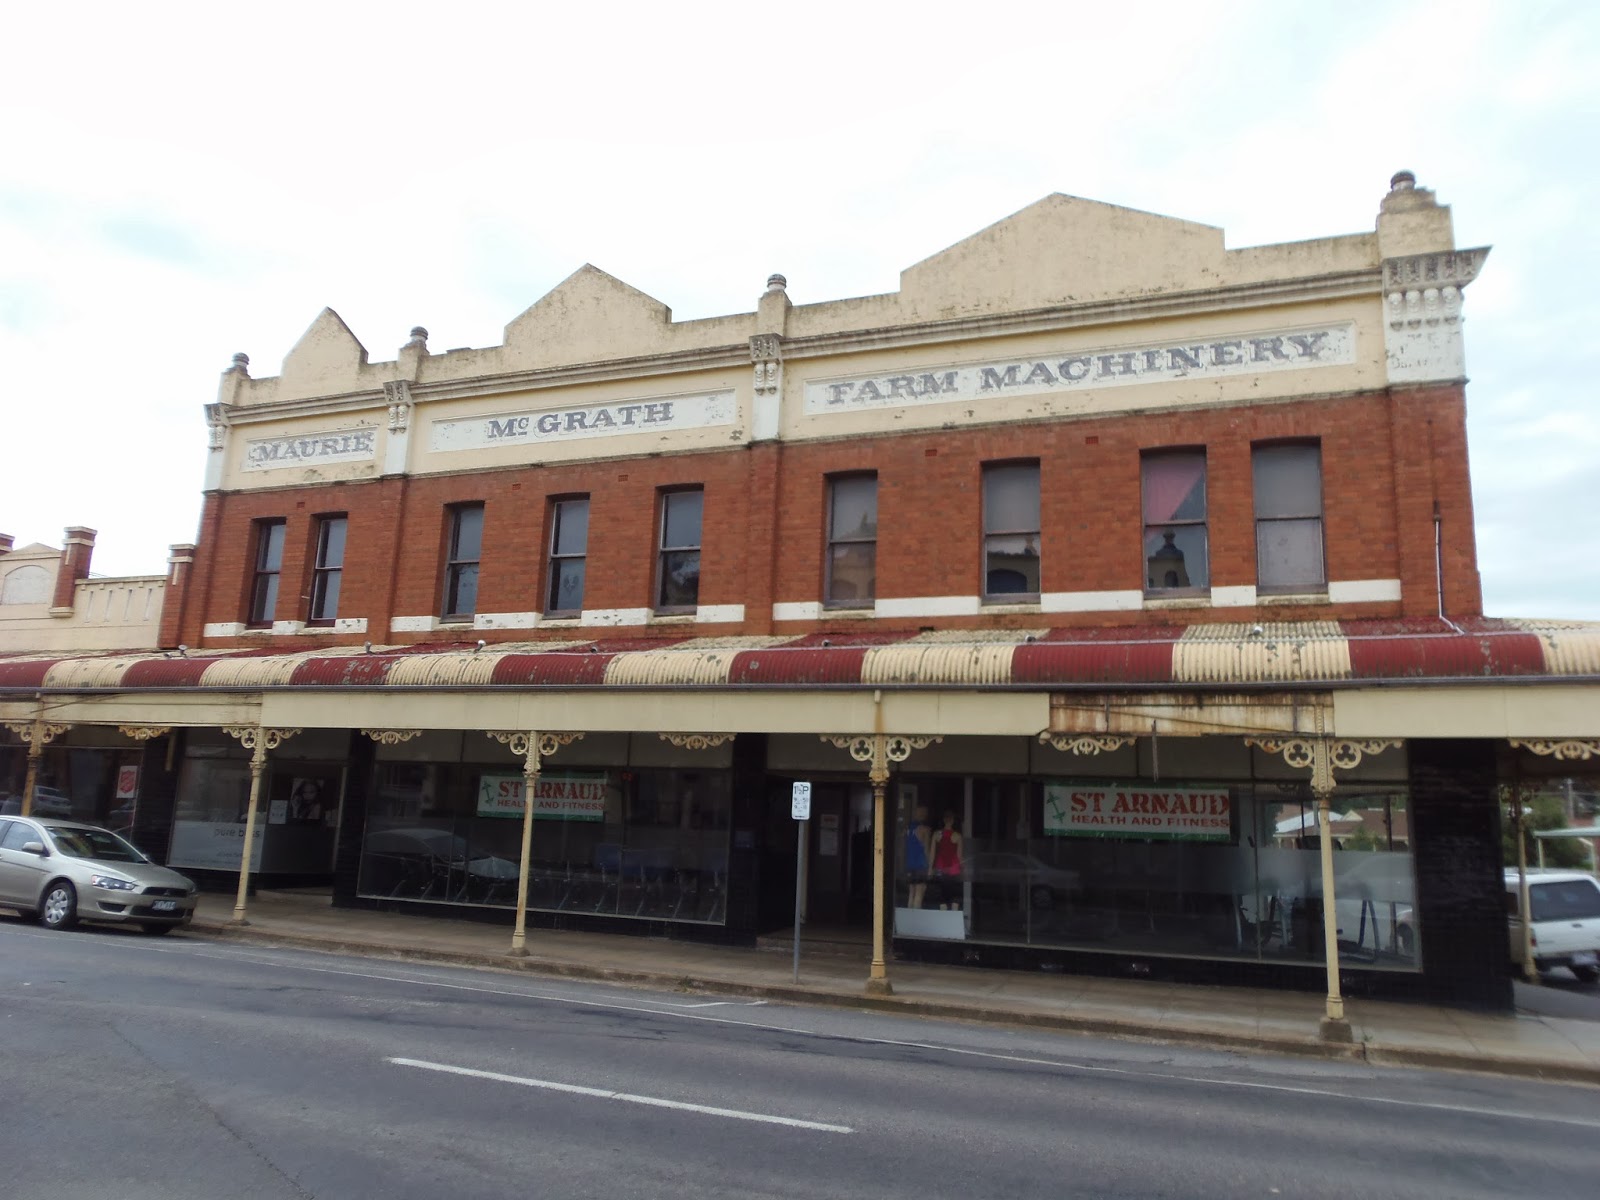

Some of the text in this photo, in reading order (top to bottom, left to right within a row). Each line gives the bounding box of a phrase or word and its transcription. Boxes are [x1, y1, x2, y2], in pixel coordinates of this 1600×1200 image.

[829, 332, 1329, 404] FARM MACHINERY
[253, 431, 374, 461] MAURIE
[498, 781, 522, 797] ST
[497, 799, 605, 810] HEAL AND FITNESS
[1071, 792, 1230, 815] ST ARNAUD
[1071, 815, 1230, 828] HEALTH AND FITNESS
